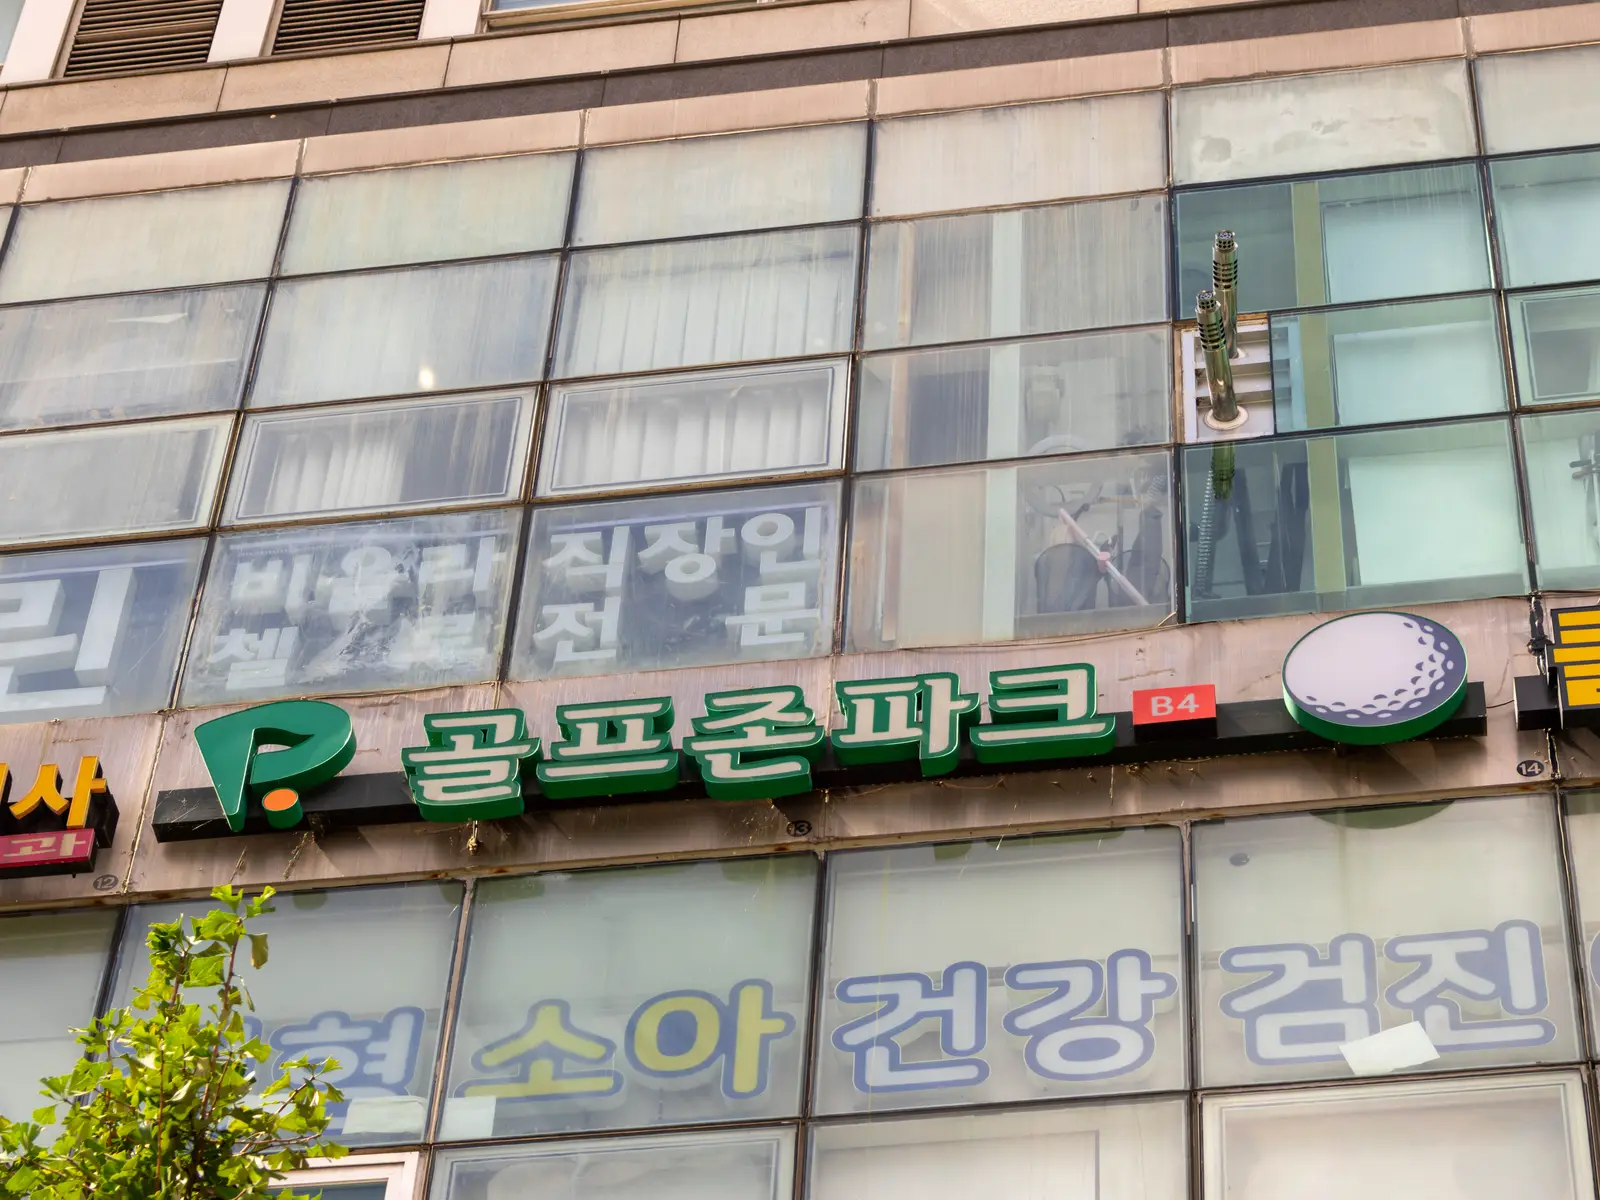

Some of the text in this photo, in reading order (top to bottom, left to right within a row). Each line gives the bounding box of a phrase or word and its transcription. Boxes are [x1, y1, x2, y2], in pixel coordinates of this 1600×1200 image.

[542, 505, 824, 595] 직장인
[533, 580, 820, 663] 전문
[401, 661, 1117, 822] 골프존파크
[1150, 693, 1200, 716] B4
[0, 755, 108, 830] 사
[454, 979, 797, 1100] 소아
[831, 948, 1179, 1094] 건강
[1218, 919, 1558, 1067] 검진
